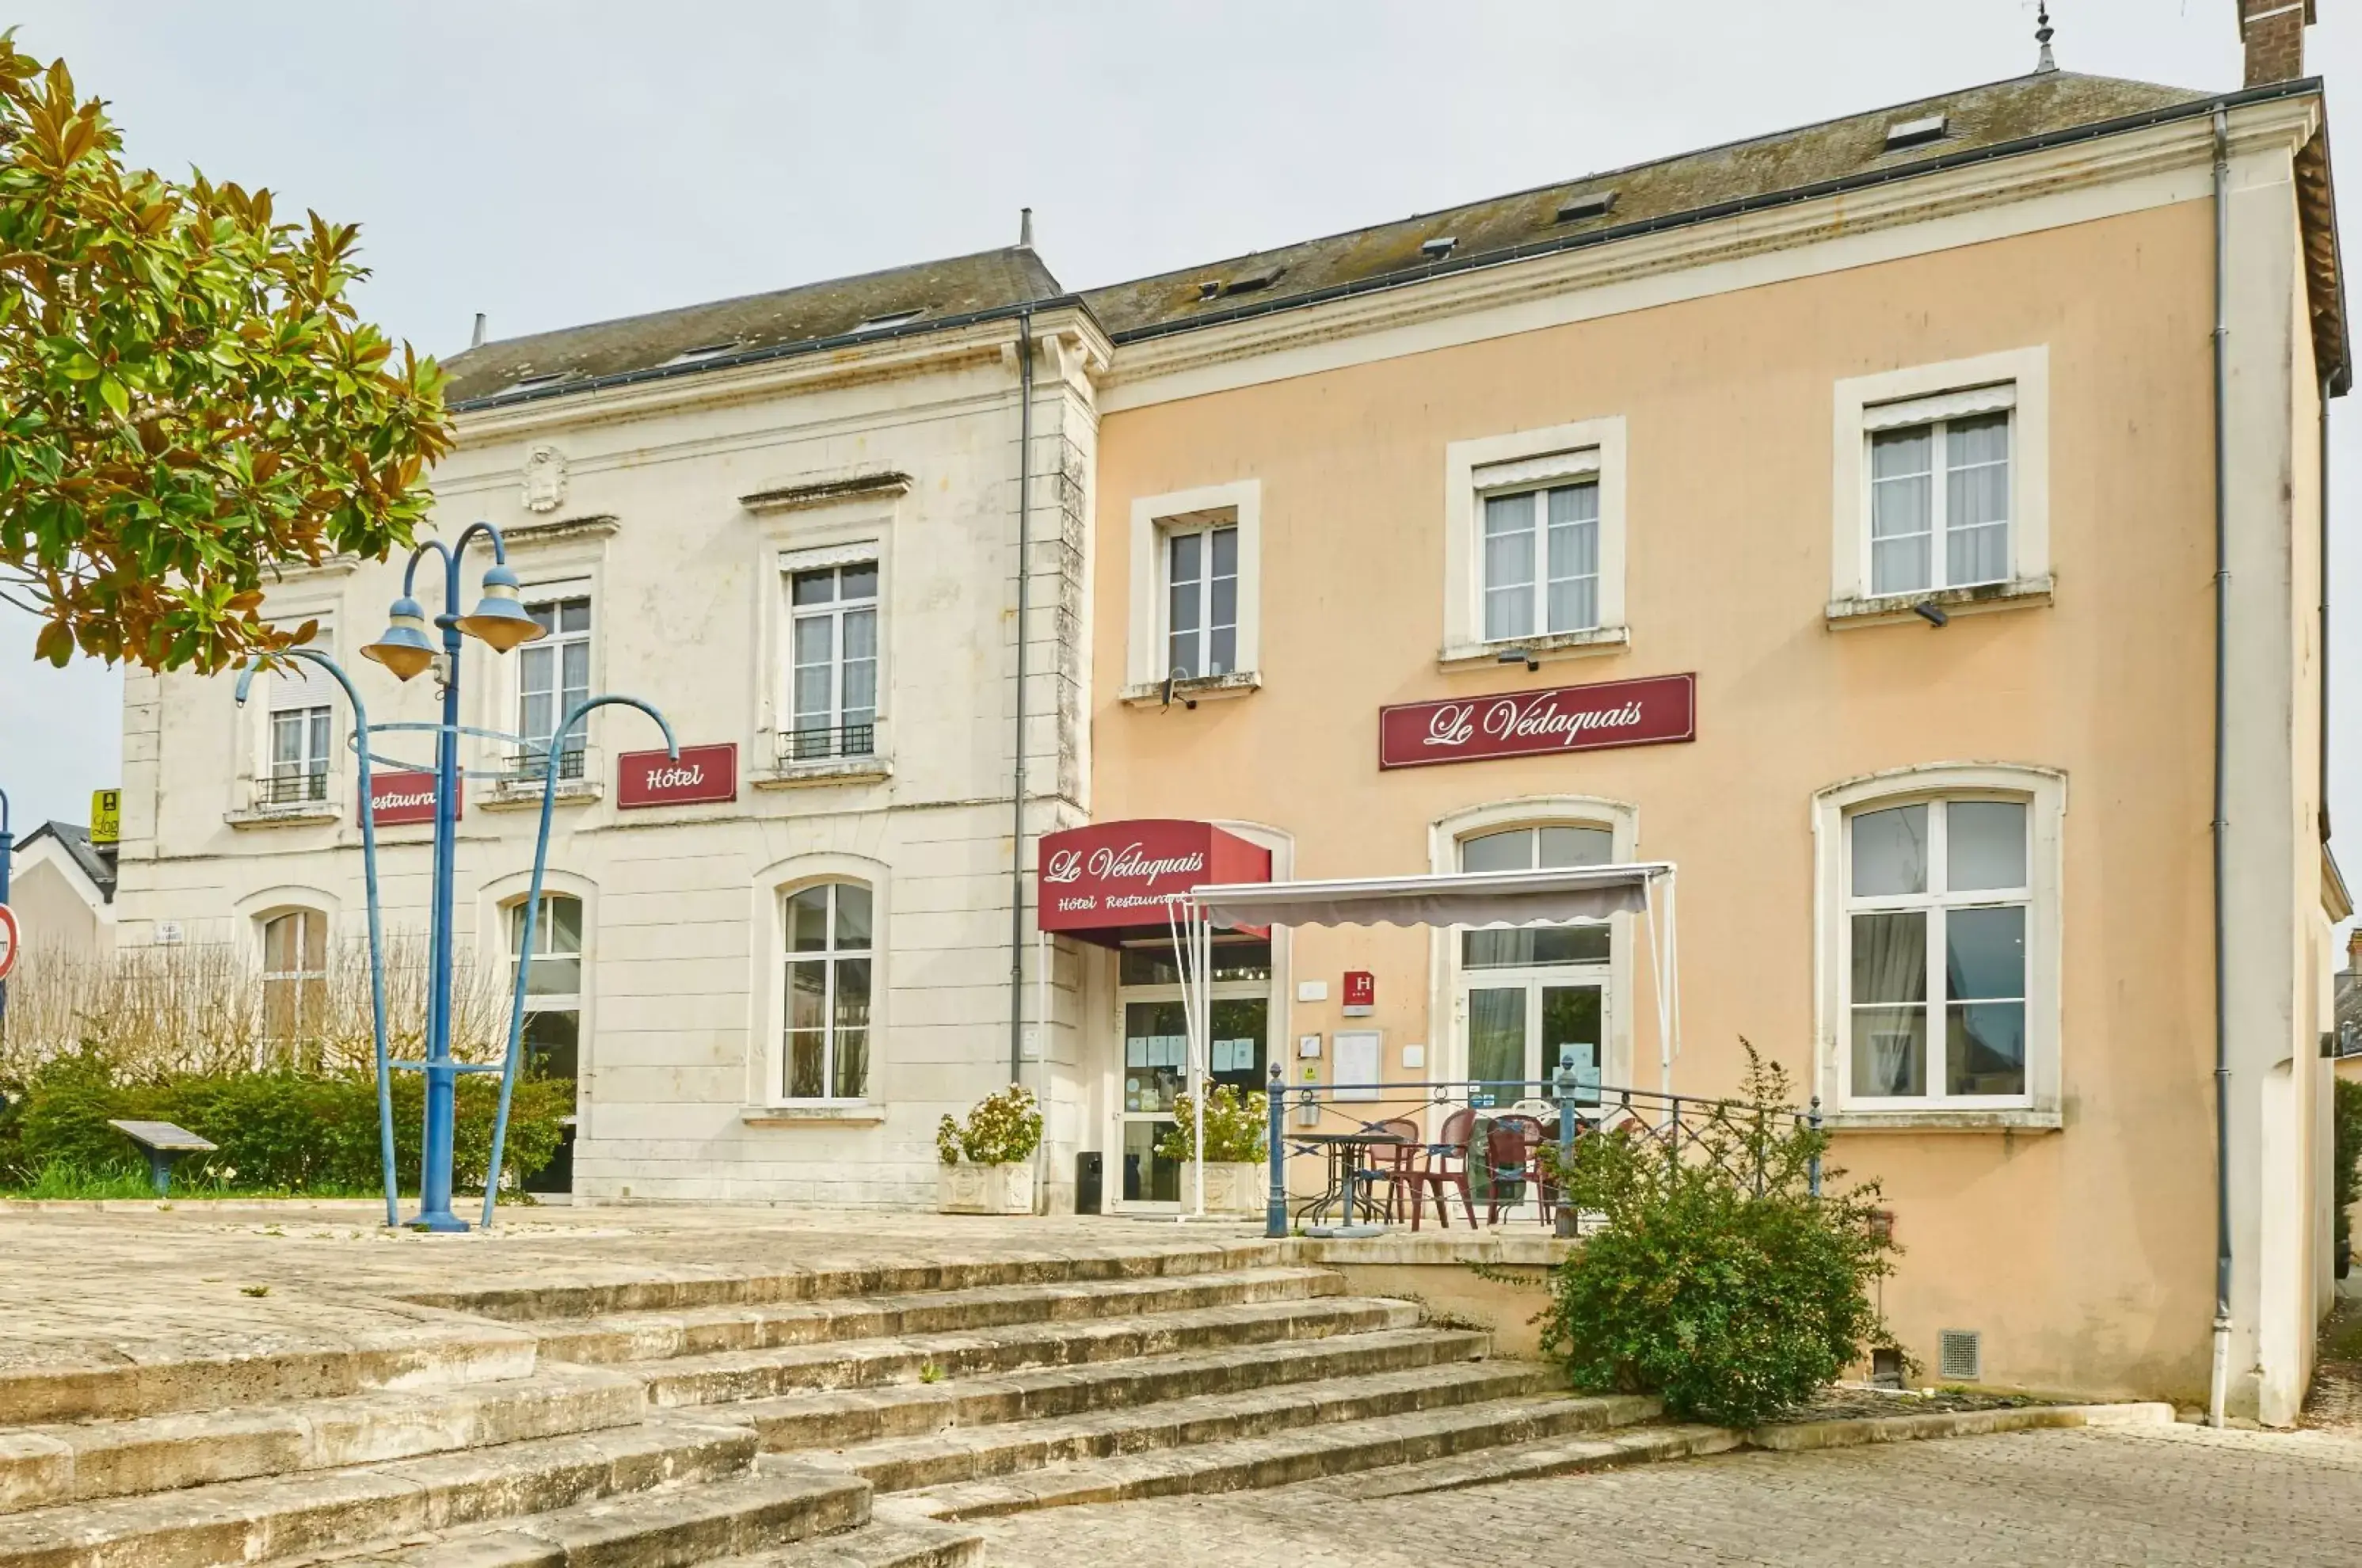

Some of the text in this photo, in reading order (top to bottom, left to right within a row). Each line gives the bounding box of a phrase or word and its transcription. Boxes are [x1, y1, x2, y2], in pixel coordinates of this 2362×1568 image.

[1423, 691, 1642, 746] Le Védaquais
[646, 764, 705, 791] Hôtel
[371, 791, 437, 810] estaura
[1044, 842, 1204, 886] Le Védaquais
[1057, 895, 1098, 912] Hôtel
[1355, 976, 1371, 990] H
